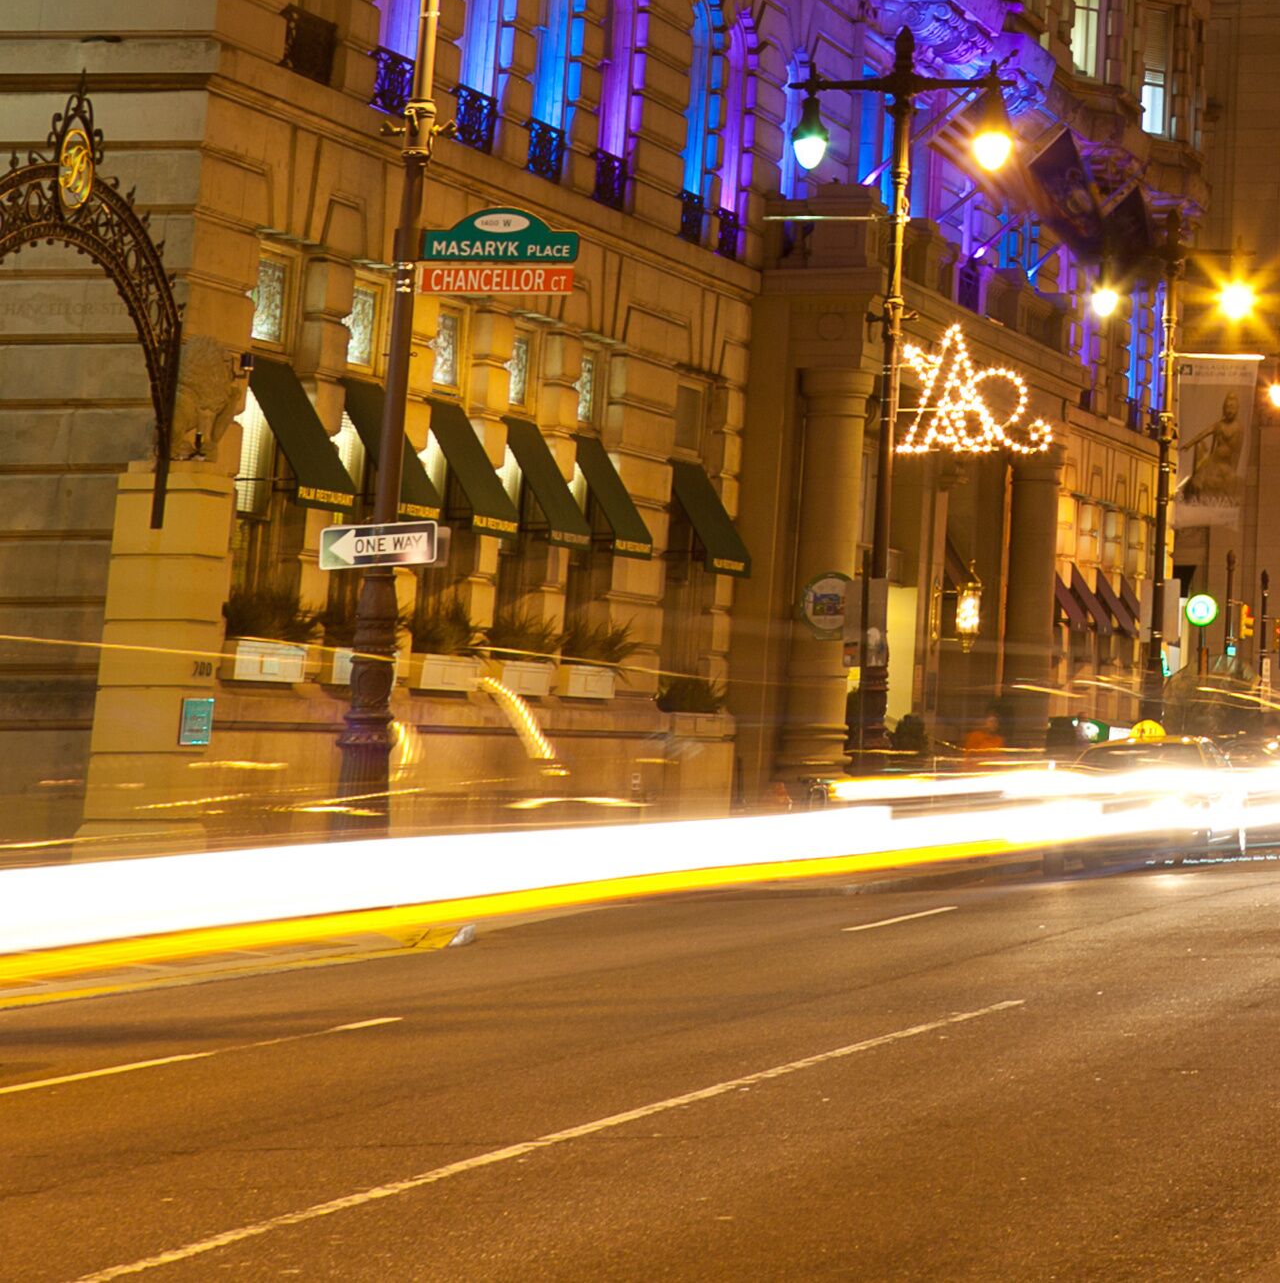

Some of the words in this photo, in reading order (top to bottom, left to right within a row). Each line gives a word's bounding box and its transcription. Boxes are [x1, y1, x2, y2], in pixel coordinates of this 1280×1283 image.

[502, 219, 512, 227] W
[432, 240, 519, 256] MASARYK
[527, 245, 570, 257] PLACE
[431, 269, 545, 291] CHANCELLOR
[550, 276, 566, 291] CT
[316, 489, 354, 506] RESTAURANT
[355, 538, 387, 554] ONE
[392, 534, 423, 551] WAY
